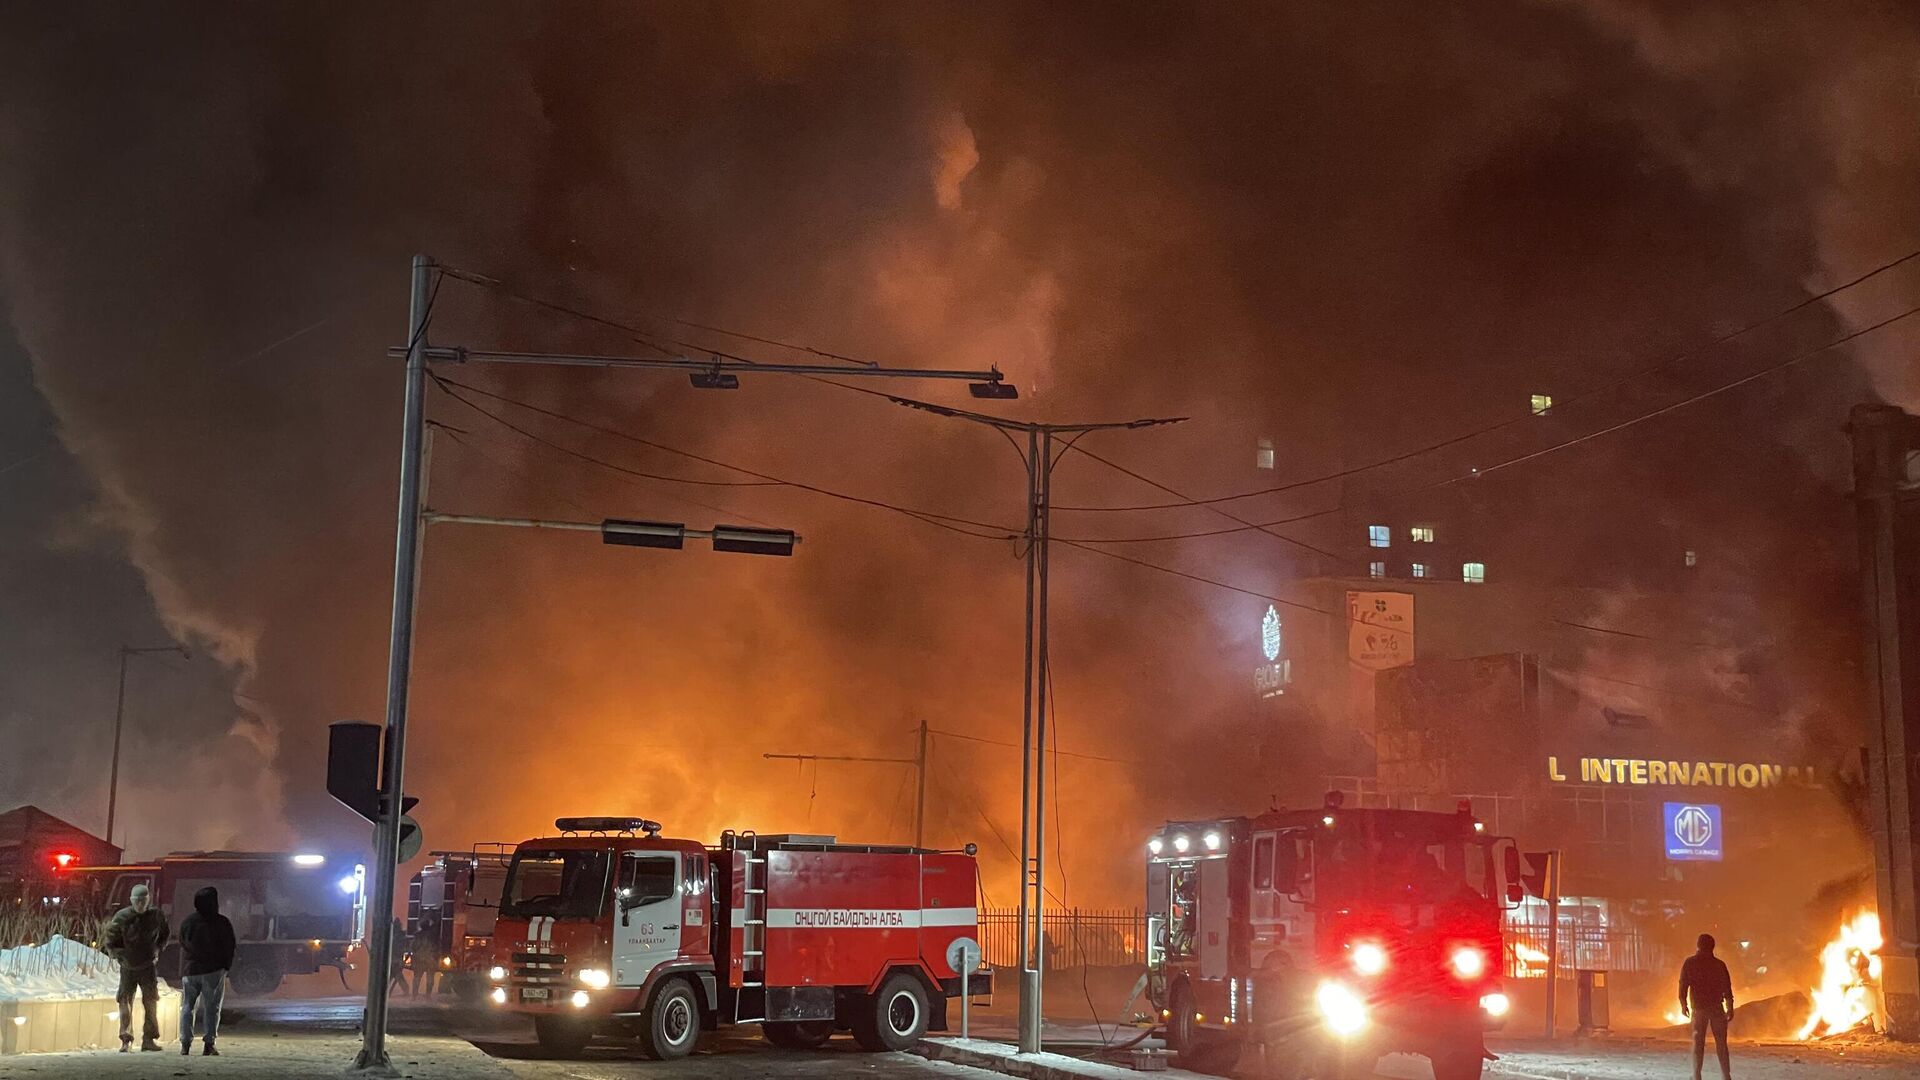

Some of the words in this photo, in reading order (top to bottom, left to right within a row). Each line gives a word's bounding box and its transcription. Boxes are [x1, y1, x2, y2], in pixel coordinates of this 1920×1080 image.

[1549, 757, 1566, 781] L
[1679, 810, 1708, 843] MG
[795, 909, 831, 928] ОНЦГОЙ
[833, 909, 877, 928] БАЙДЛЫН
[880, 912, 904, 926] АЛБА
[641, 923, 654, 936] 63
